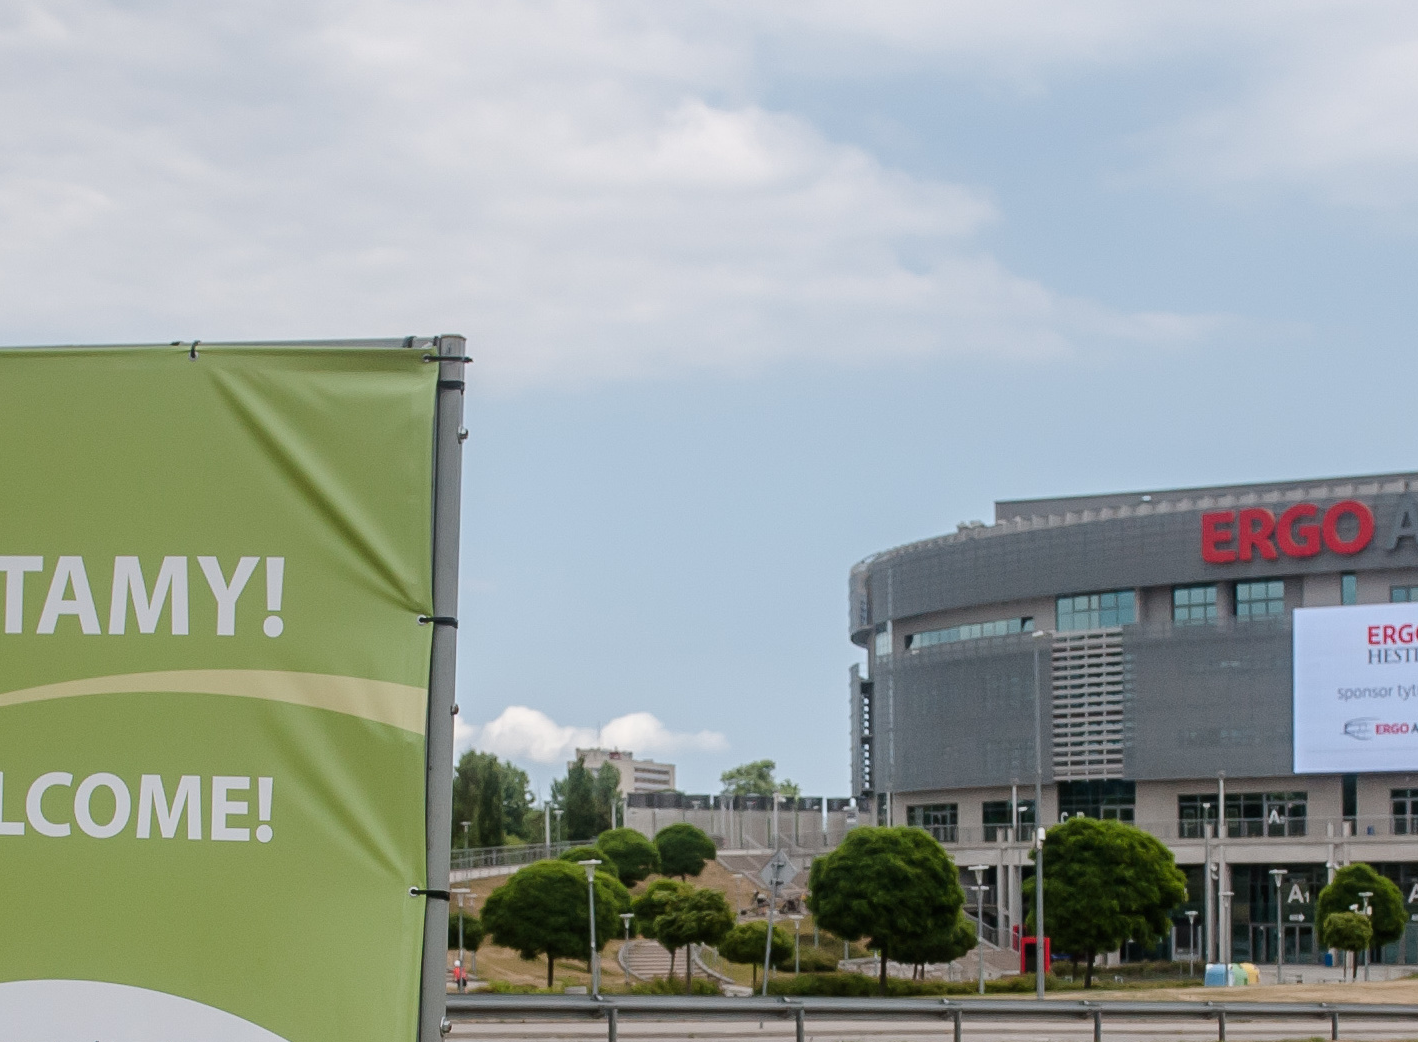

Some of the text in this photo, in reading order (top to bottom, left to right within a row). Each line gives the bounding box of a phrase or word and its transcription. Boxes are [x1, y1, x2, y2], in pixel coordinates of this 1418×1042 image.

[1202, 500, 1375, 564] ERGO
[1337, 686, 1393, 701] sponsor
[1375, 722, 1409, 735] ERGO
[1288, 884, 1310, 904] A1
